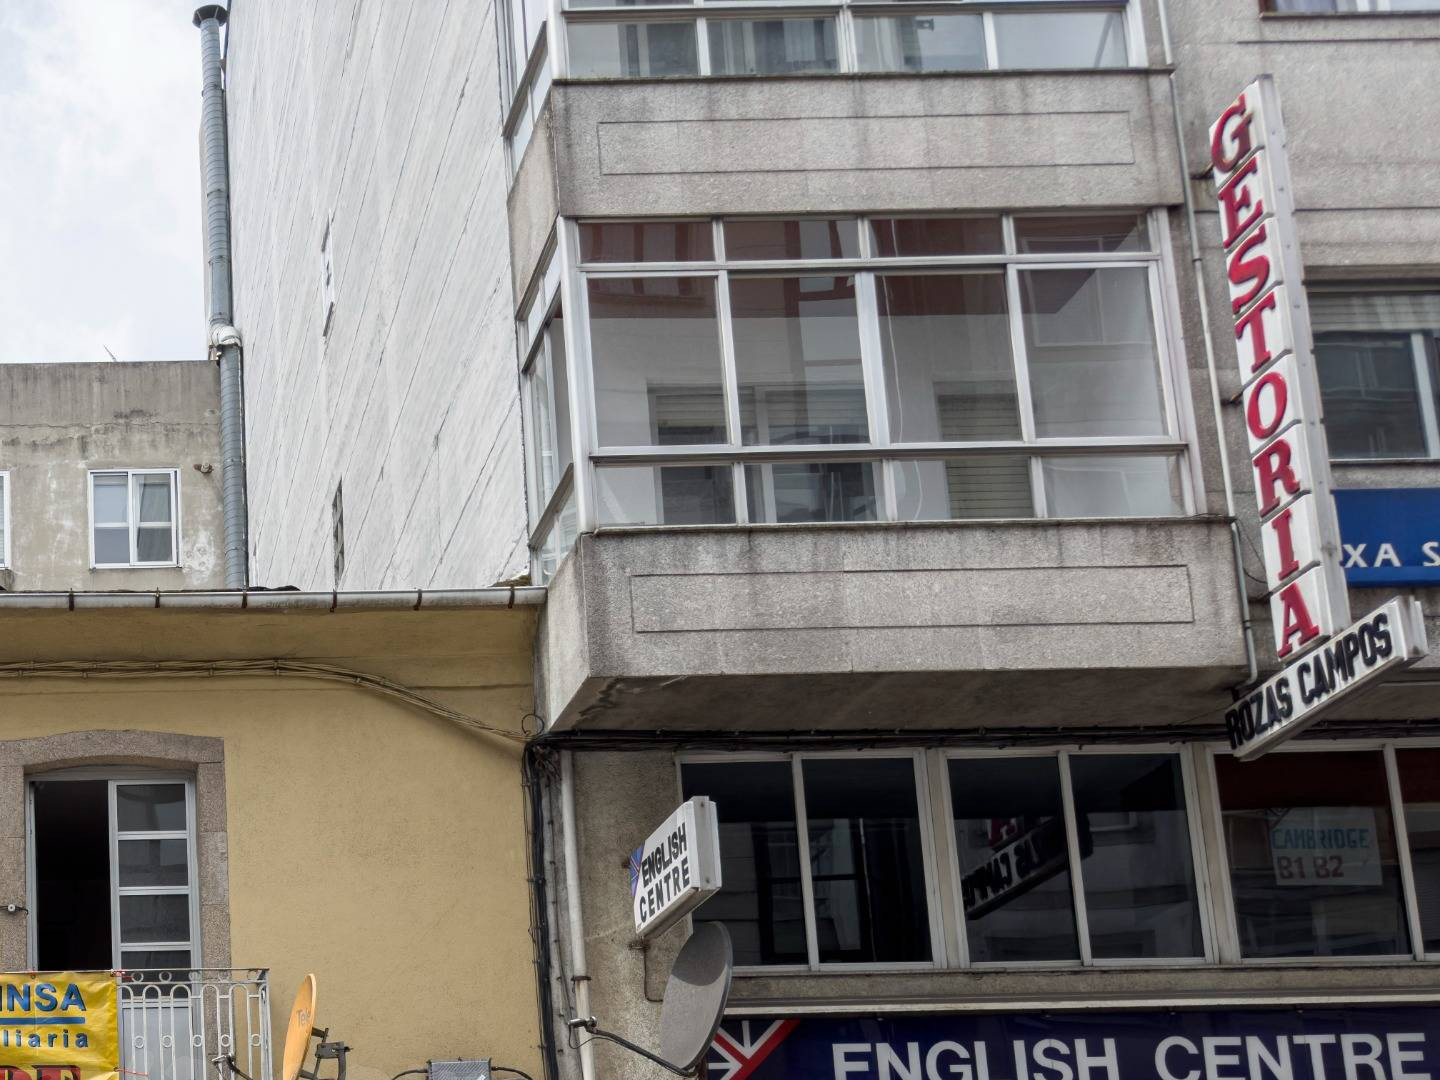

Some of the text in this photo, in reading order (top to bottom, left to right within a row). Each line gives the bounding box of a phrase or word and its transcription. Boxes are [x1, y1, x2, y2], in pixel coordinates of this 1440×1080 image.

[1210, 94, 1320, 659] GESTORIA
[1224, 612, 1393, 750] ROZAS CAMPOS
[641, 822, 688, 889] ENGLISH
[1271, 828, 1370, 849] CAMBRIDGE
[1277, 855, 1344, 879] B1 B2
[639, 856, 690, 923] CENTRE
